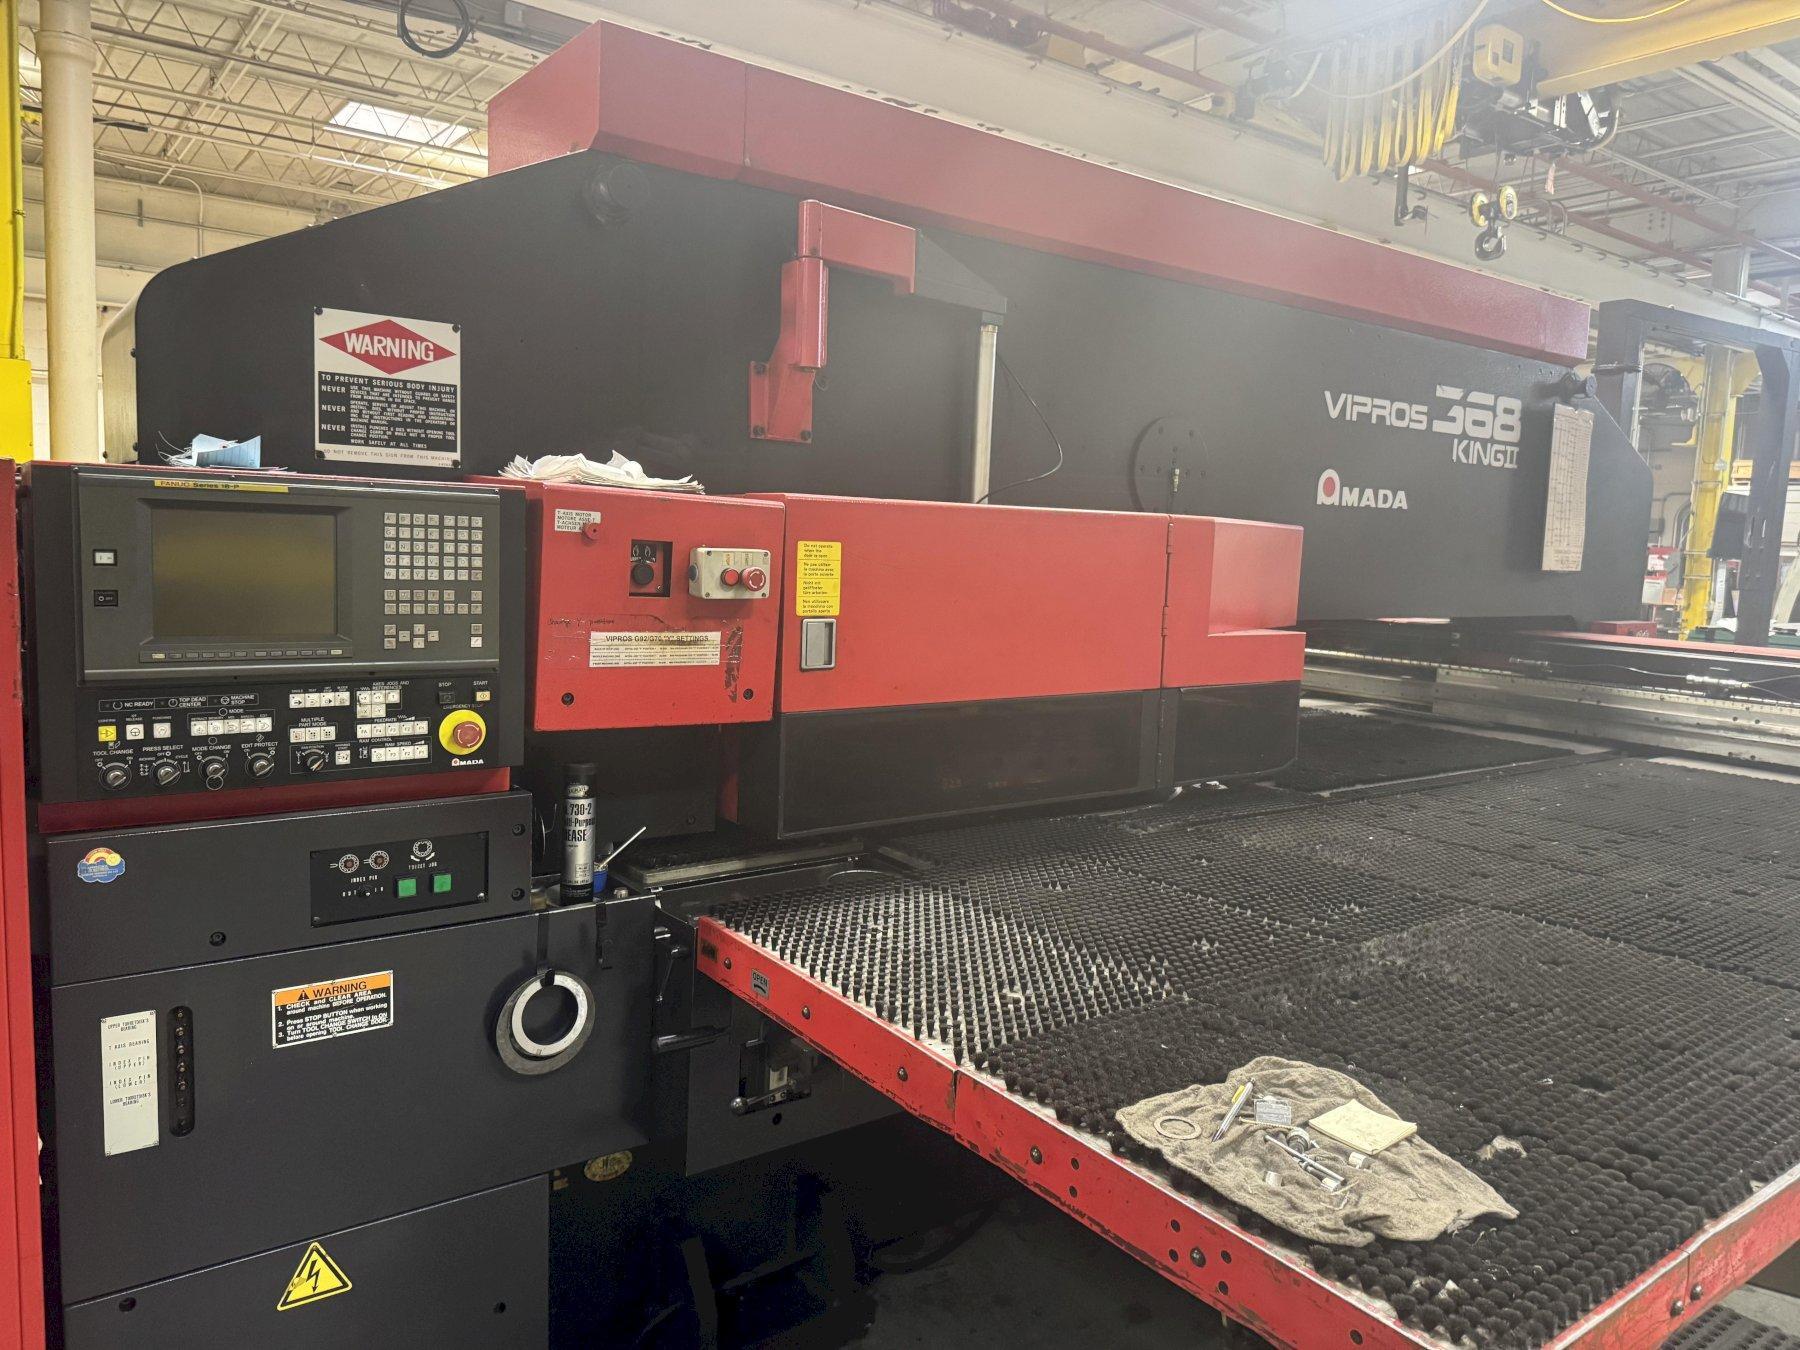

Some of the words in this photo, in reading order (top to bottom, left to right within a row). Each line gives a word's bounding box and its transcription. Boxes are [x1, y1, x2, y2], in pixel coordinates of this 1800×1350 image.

[344, 331, 434, 362] WARNING
[321, 373, 332, 381] TO
[335, 375, 369, 385] PREVENT
[372, 379, 403, 389] SERIOUS
[406, 383, 425, 391] BODY
[428, 385, 455, 393] INJURY
[321, 385, 346, 394] NEVER
[321, 405, 346, 413] NEVER
[1324, 390, 1428, 430] VIPROS
[1432, 384, 1522, 443] 368
[321, 424, 346, 432] NEVER
[1316, 468, 1408, 510] AMADA
[451, 757, 484, 767] AMADA
[569, 802, 593, 816] 730-2
[752, 972, 768, 987] OPEN
[313, 981, 367, 998] WARNING
[286, 1001, 311, 1010] CHECK
[328, 994, 352, 1003] CLEAR
[354, 990, 373, 998] AREA
[286, 1007, 306, 1016] around
[307, 1003, 331, 1012] machine
[332, 999, 354, 1008] BEFORE
[356, 993, 387, 1003] OPERATION.
[286, 1018, 304, 1026] Press
[304, 1013, 322, 1023] STOP
[323, 1009, 349, 1019] BUTTON
[365, 1002, 388, 1012] working
[305, 1019, 327, 1028] around
[329, 1014, 355, 1023] machine.
[120, 1024, 137, 1032] BEARING
[286, 1033, 305, 1042] before
[305, 1029, 328, 1039] opening
[328, 1026, 345, 1034] TOOL
[346, 1021, 370, 1031] CHANGE
[370, 1016, 389, 1025] DOOR.
[302, 1025, 320, 1033] TOOL
[321, 1020, 347, 1029] CHANGE
[347, 1015, 371, 1024] SWITCH
[128, 1038, 150, 1048] BEARING
[122, 1099, 139, 1107] BEARING
